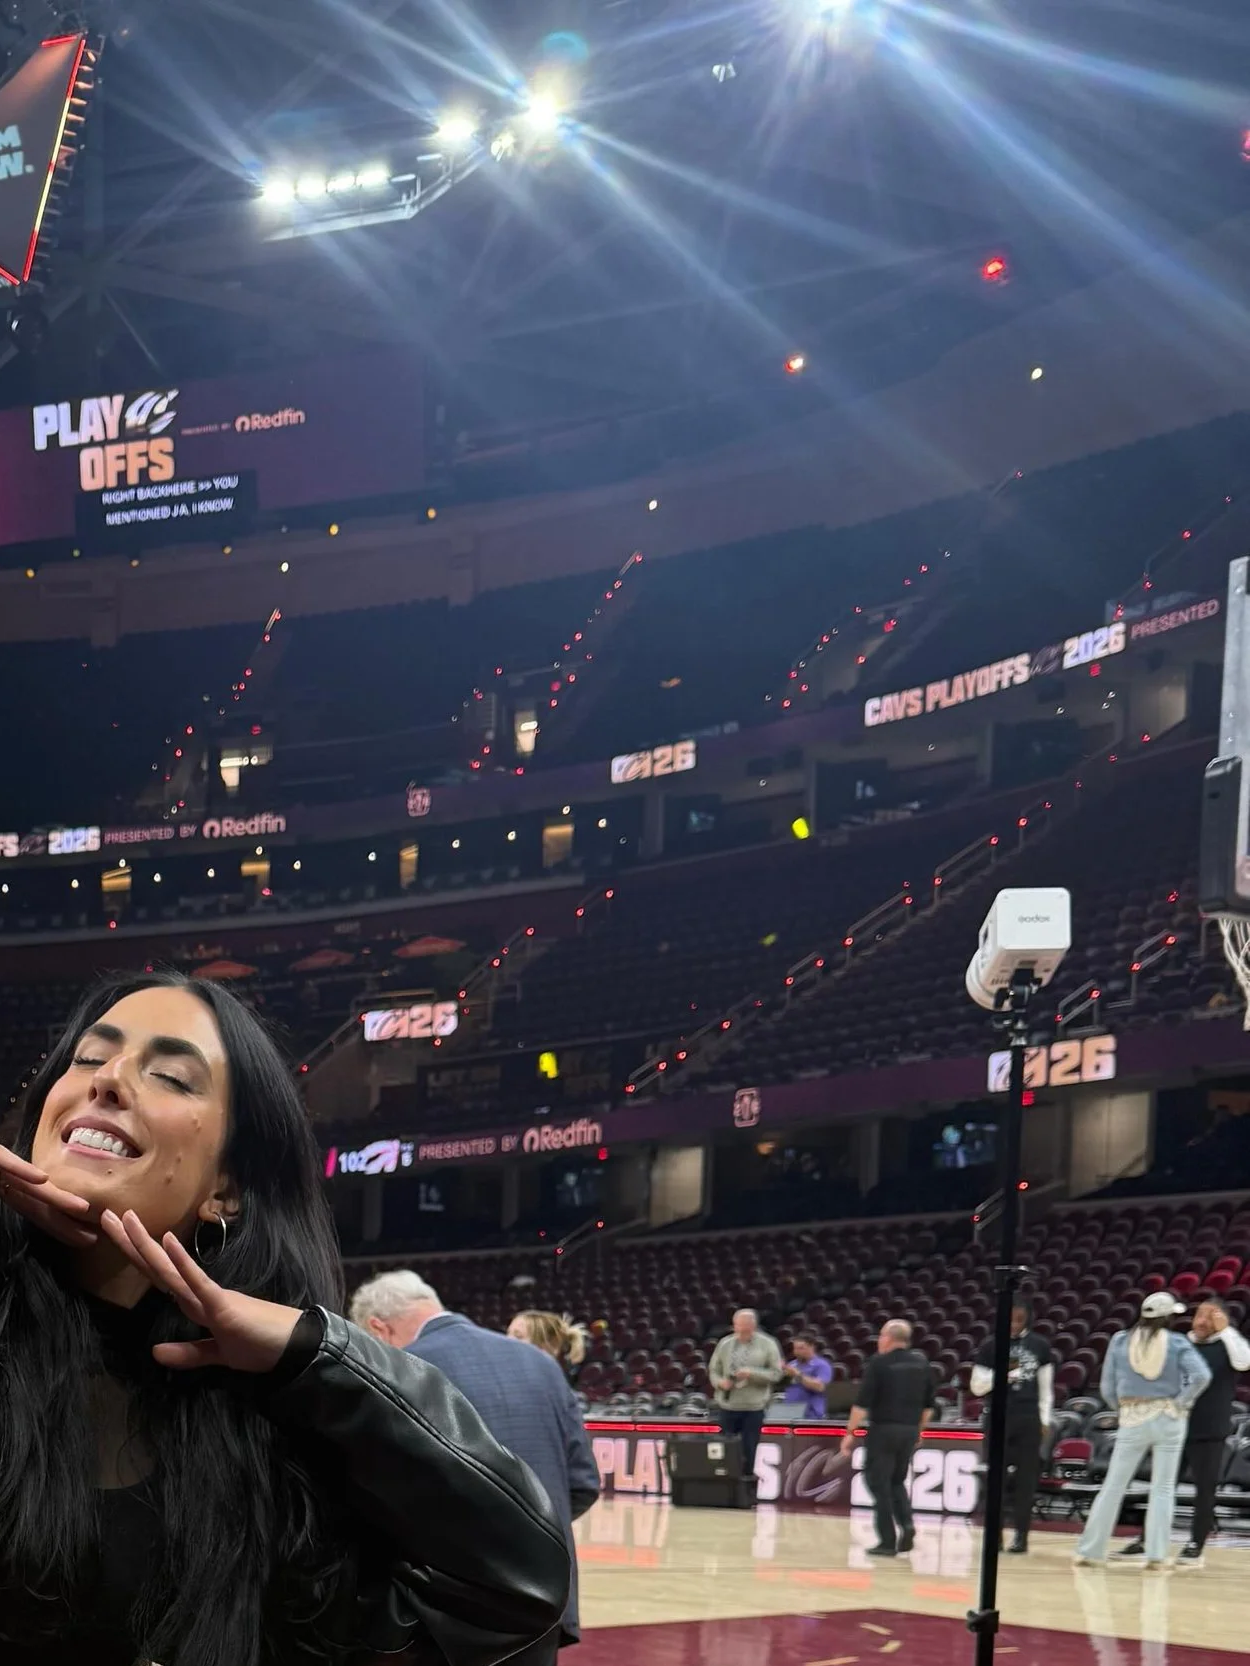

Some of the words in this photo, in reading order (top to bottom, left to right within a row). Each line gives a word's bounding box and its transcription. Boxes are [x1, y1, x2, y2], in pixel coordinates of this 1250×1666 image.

[33, 394, 125, 451] PLAY
[250, 407, 306, 431] Redfin
[79, 437, 175, 492] OFFS
[212, 473, 239, 490] YOU
[106, 506, 171, 526] MENTIONED
[864, 687, 924, 727] CAVS
[925, 653, 1031, 714] PLAYOFFS
[1062, 621, 1126, 671] 2026
[1130, 600, 1220, 640] PRESENTED
[48, 826, 101, 854] 2026
[103, 827, 175, 845] PRESENTED
[180, 824, 197, 838] BY
[221, 813, 287, 838] Redfin
[419, 1137, 496, 1160] PRESENTED
[501, 1134, 518, 1152] BY
[539, 1118, 602, 1150] Redfin
